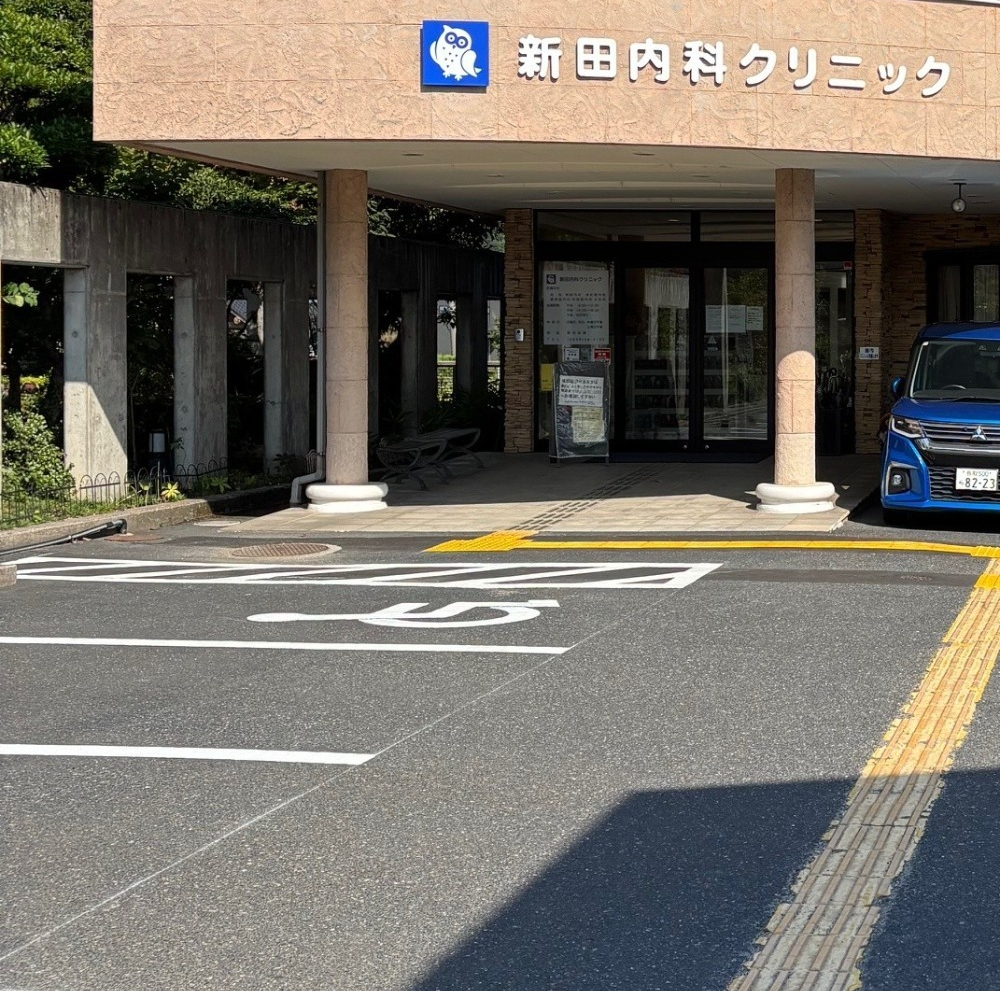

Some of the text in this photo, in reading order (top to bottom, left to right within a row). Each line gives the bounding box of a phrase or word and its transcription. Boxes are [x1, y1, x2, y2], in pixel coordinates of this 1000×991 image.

[518, 35, 951, 97] 新田内科クリニック
